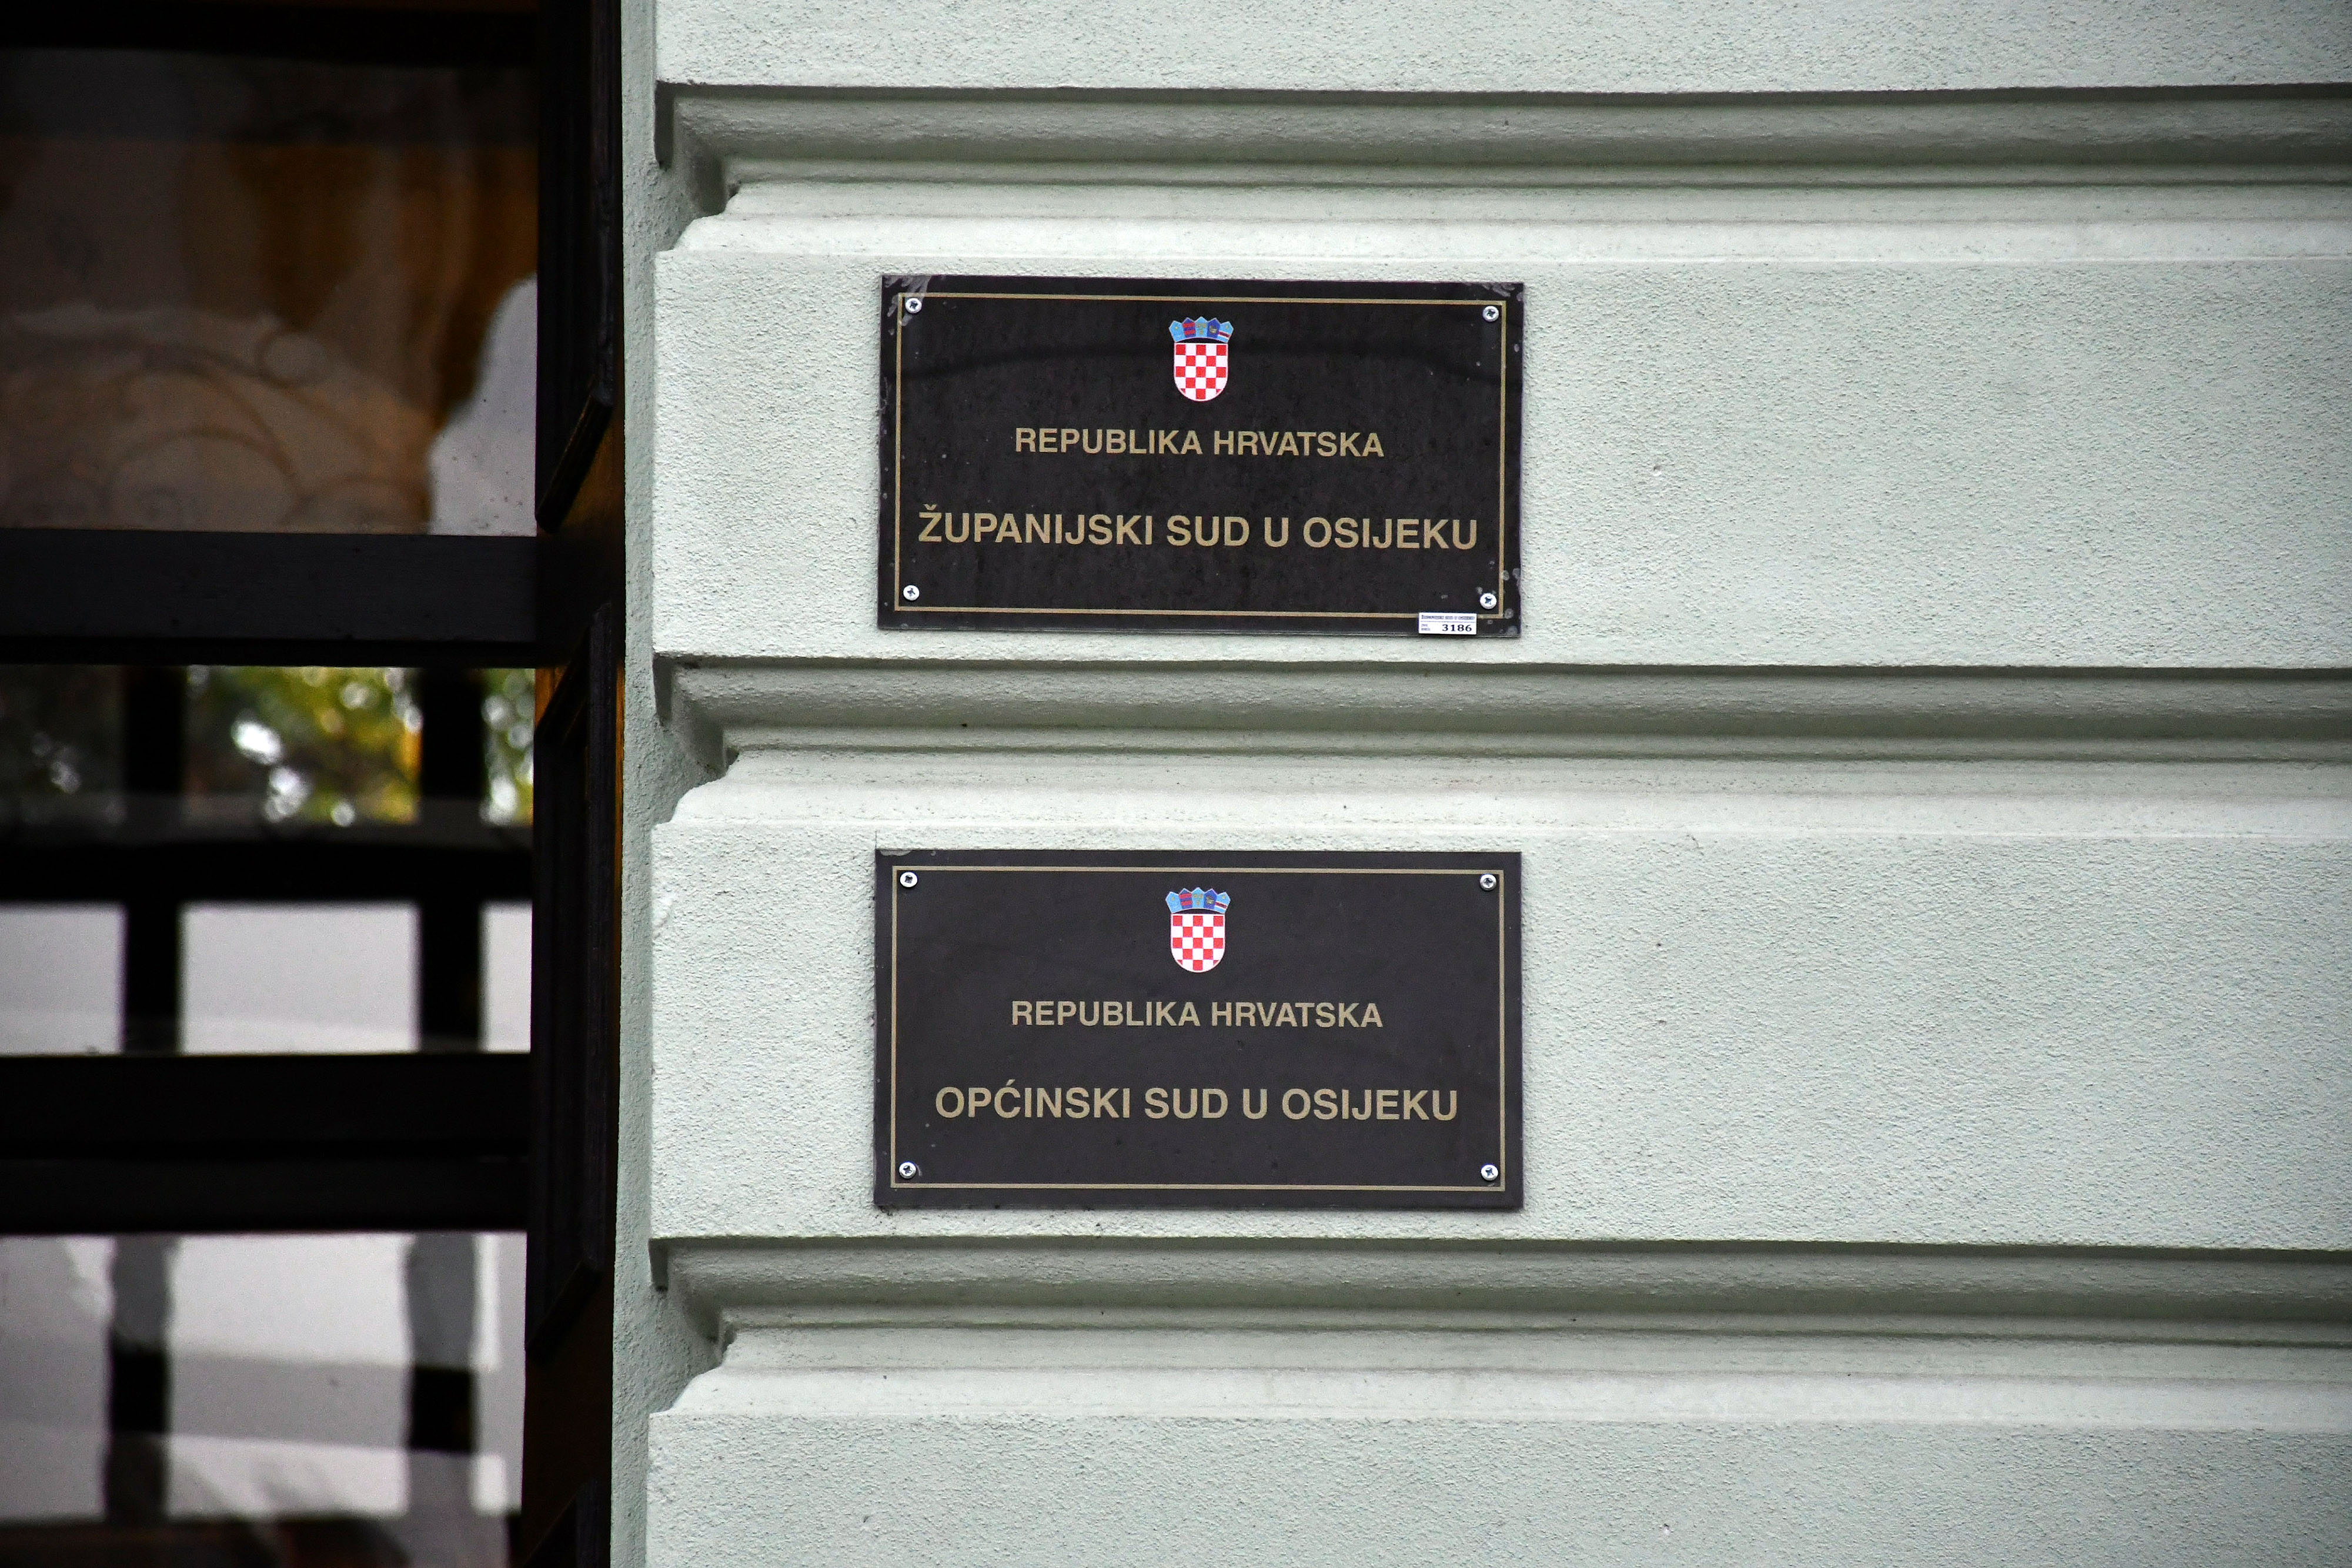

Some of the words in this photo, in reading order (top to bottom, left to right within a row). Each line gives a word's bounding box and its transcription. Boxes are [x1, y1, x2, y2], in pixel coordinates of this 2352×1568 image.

[1015, 428, 1203, 454] REPUBLIKA
[1214, 430, 1385, 457] HRVATSKA
[919, 504, 1152, 546] ŽUPANIJSKI
[1167, 515, 1250, 547] SUD
[1264, 517, 1289, 547] U
[1303, 517, 1477, 550] OSIJEKU
[1442, 624, 1472, 632] 3186
[1013, 1001, 1201, 1027] REPUBLIKA
[1211, 1002, 1382, 1028] HRVATSKA
[936, 1079, 1130, 1119] OPĆINSKI
[1145, 1088, 1228, 1119] SUD
[1243, 1088, 1268, 1119] U
[1282, 1088, 1458, 1121] OSIJEKU
